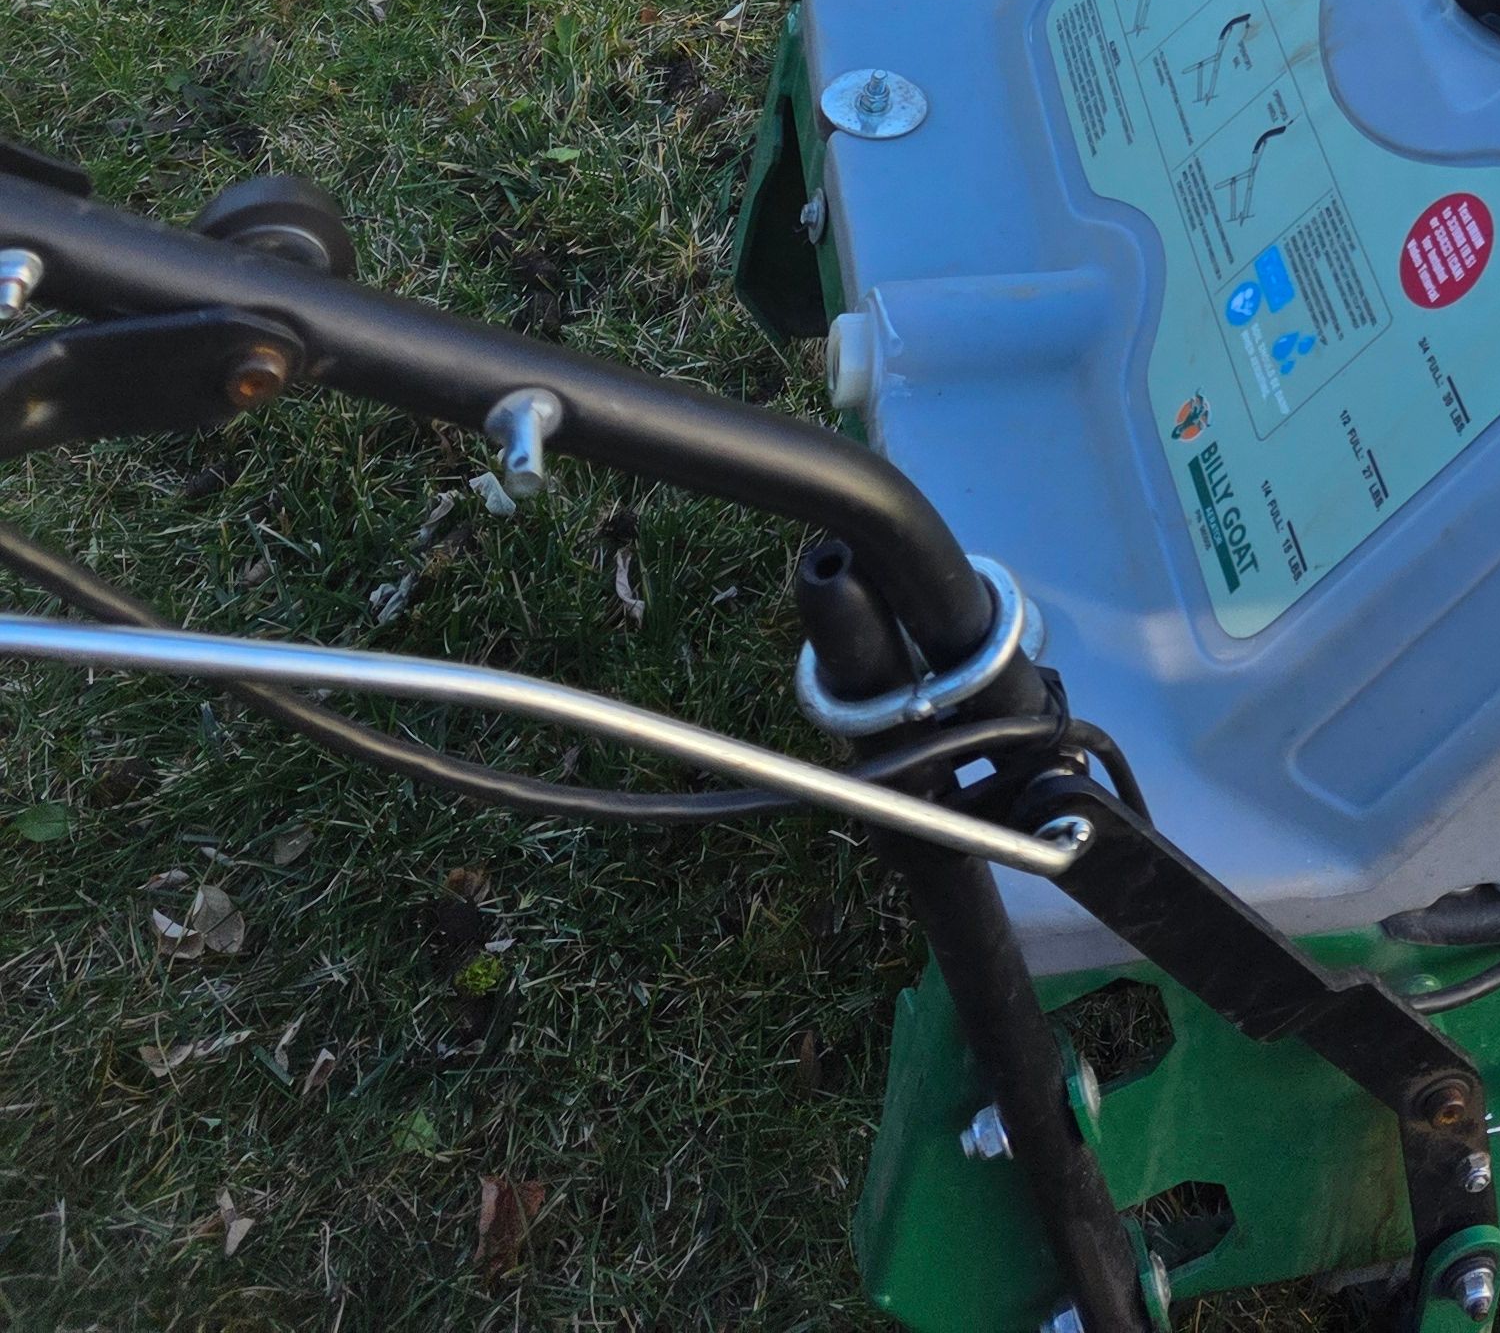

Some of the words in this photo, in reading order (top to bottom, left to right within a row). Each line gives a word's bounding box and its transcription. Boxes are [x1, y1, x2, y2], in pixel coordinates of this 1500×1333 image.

[1200, 441, 1234, 504] BILLY
[1222, 506, 1259, 574] GOAT
[1362, 465, 1373, 479] 27
